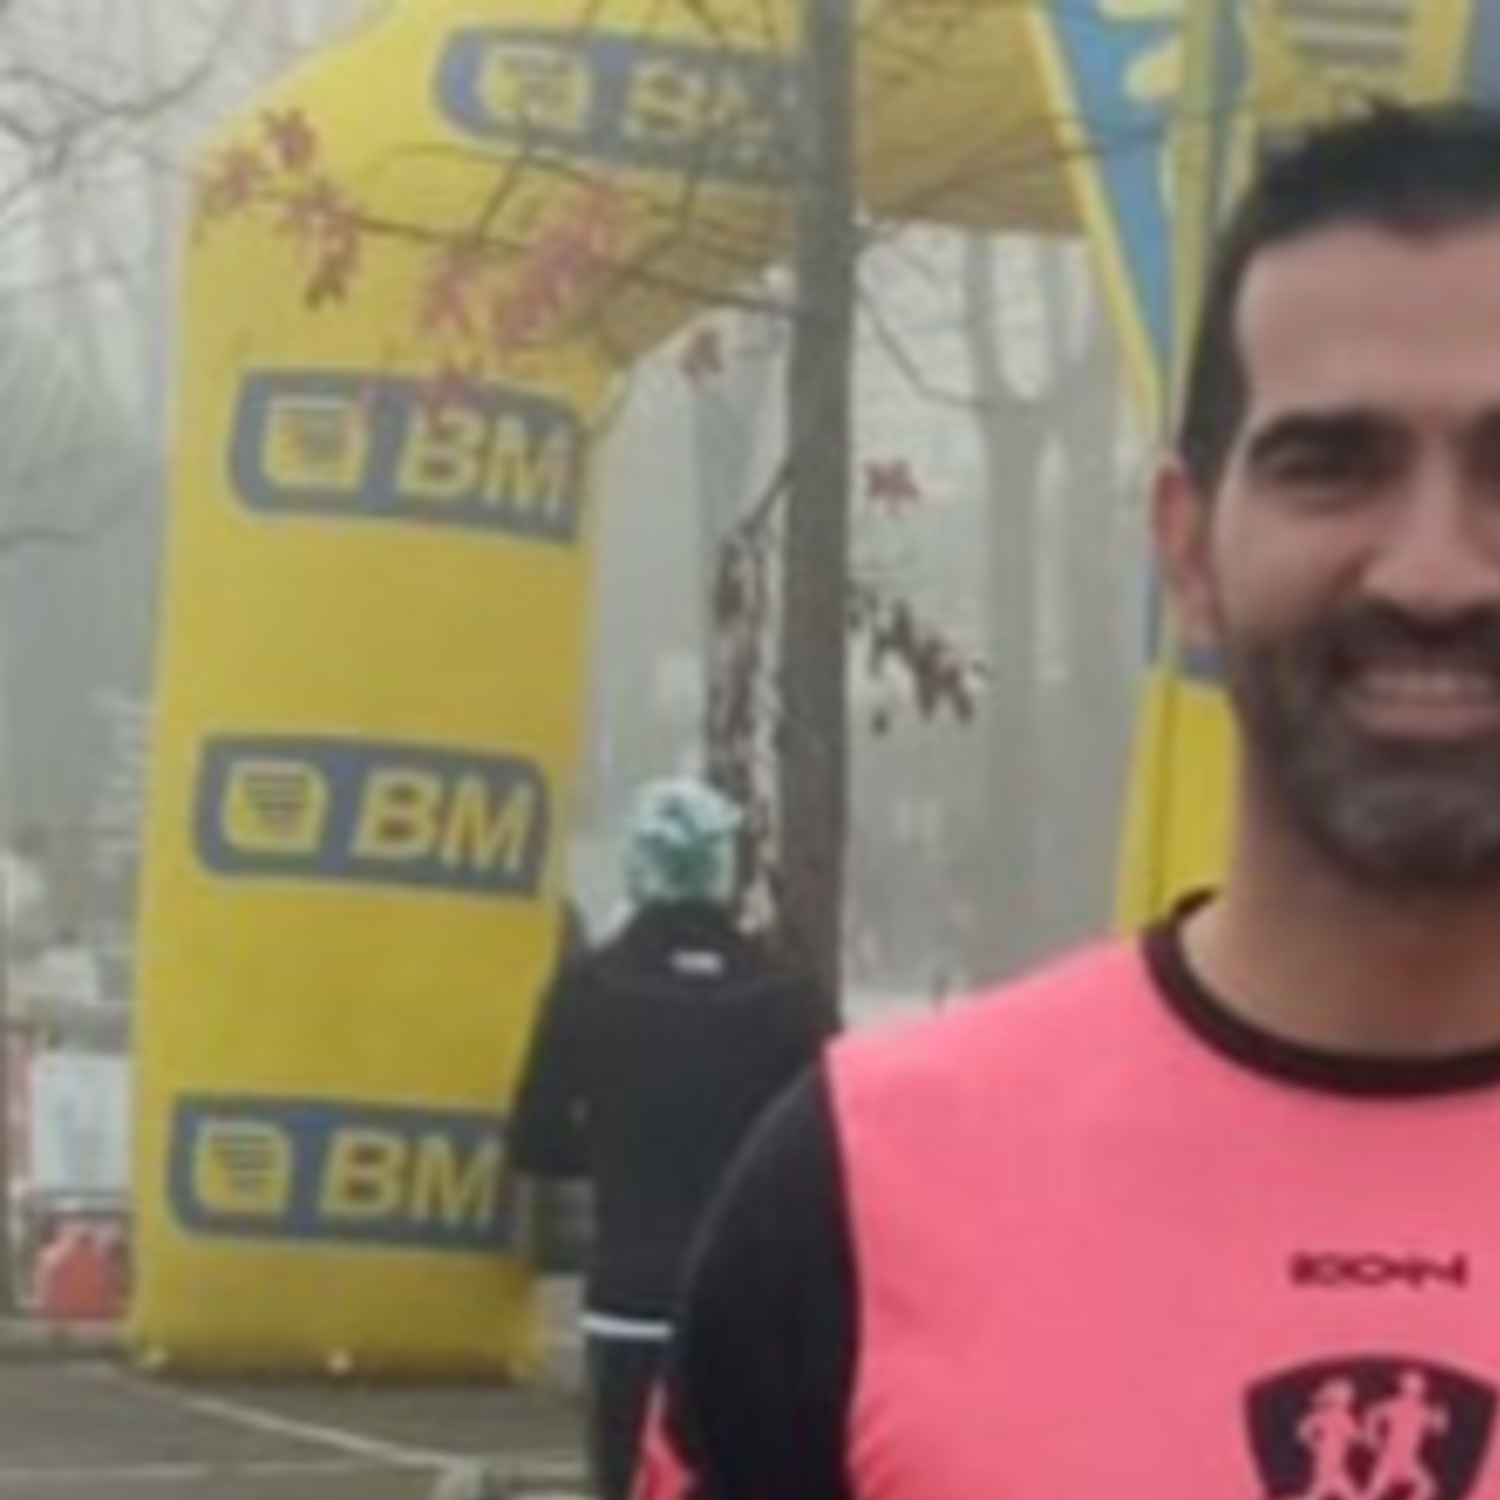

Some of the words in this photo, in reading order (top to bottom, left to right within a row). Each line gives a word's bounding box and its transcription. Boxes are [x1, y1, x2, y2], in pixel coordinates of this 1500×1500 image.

[400, 408, 574, 518] BM
[352, 768, 532, 872] BM
[318, 1130, 504, 1226] BM
